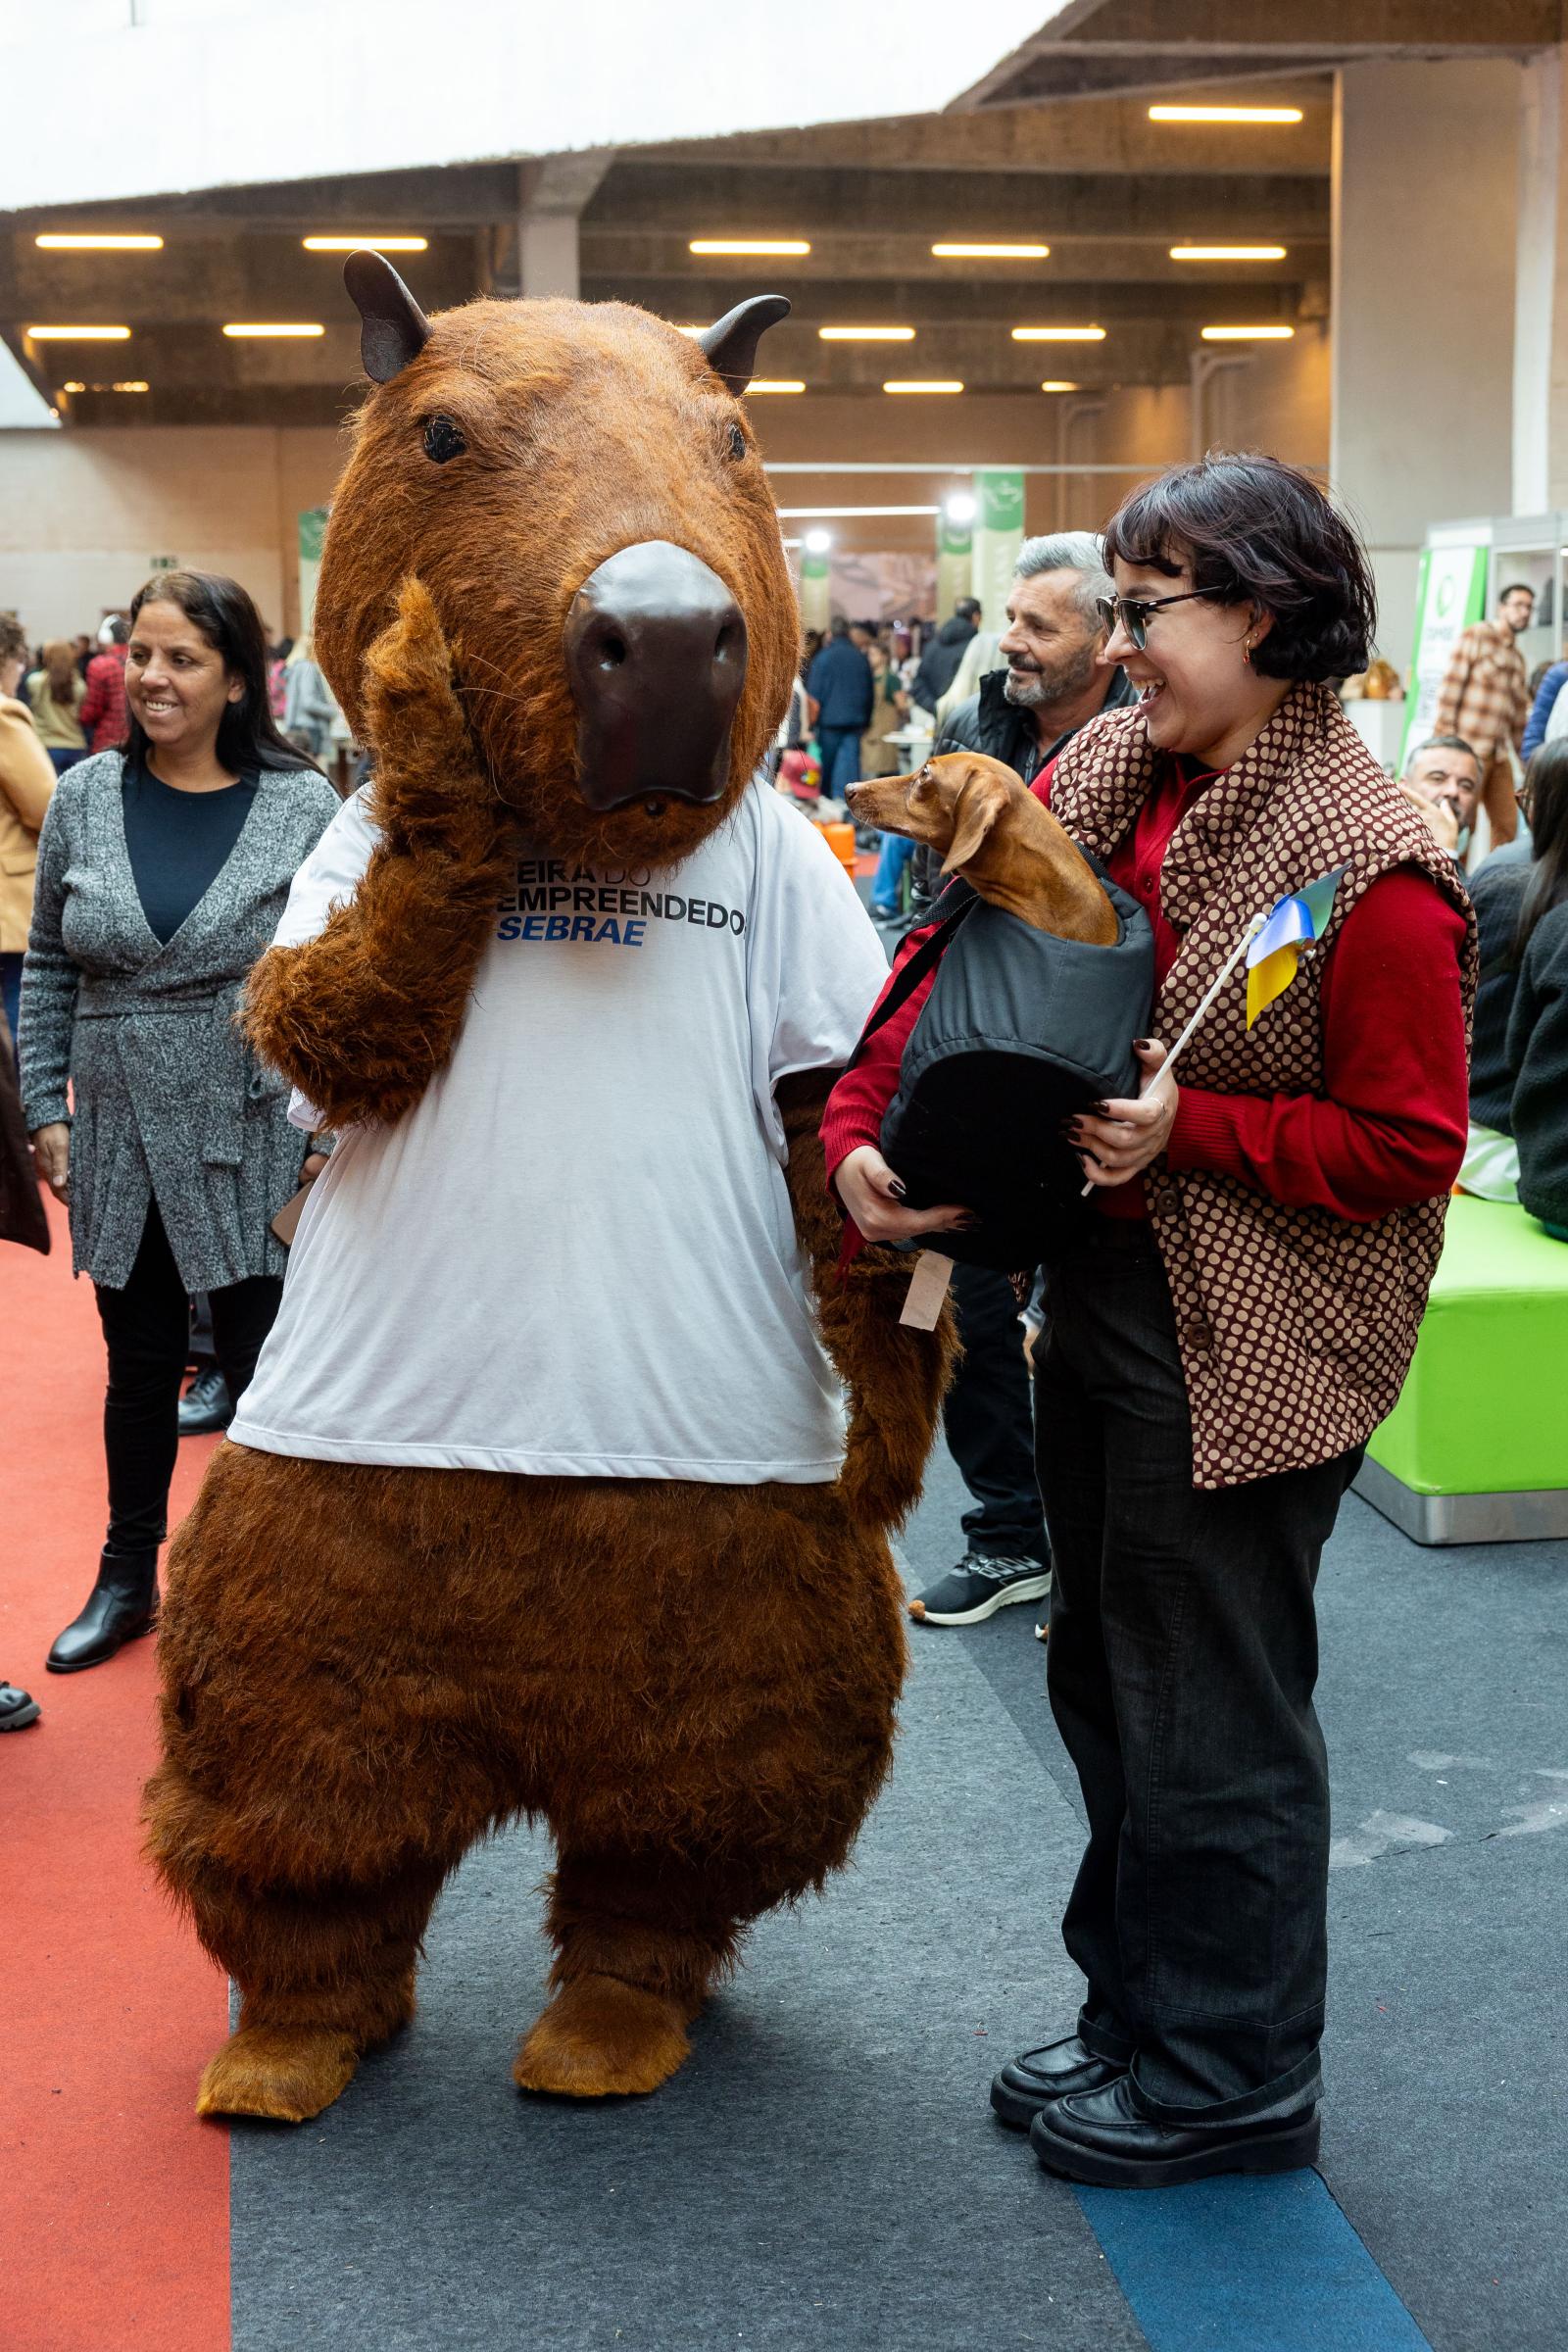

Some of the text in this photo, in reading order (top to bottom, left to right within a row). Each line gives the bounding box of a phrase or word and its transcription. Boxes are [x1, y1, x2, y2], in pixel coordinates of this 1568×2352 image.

[508, 859, 597, 884] EIRA
[497, 886, 747, 939] EMPREENDEDO
[497, 915, 647, 947] SEBRAE
